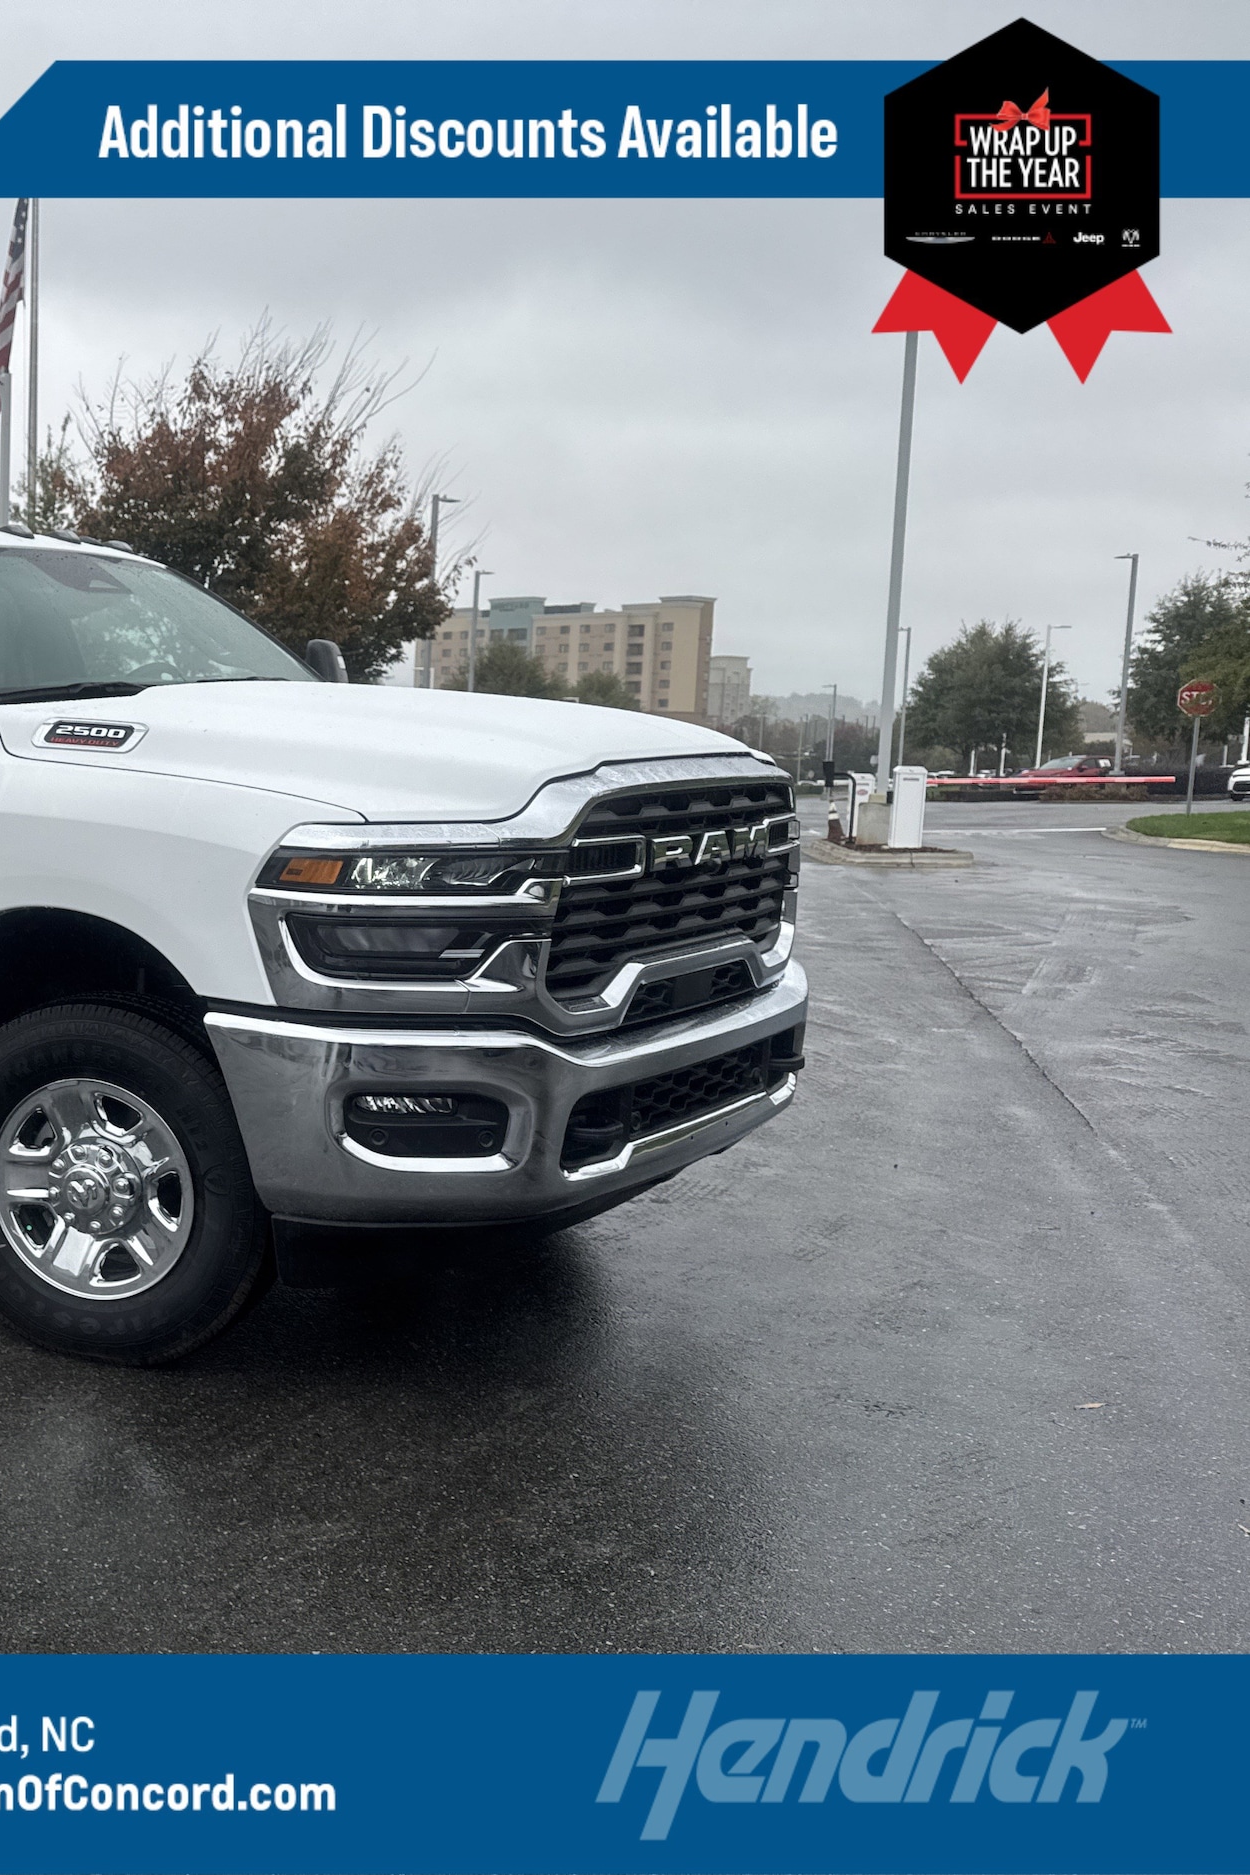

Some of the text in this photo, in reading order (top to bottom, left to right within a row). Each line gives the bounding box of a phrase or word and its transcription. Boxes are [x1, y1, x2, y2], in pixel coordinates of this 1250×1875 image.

[55, 724, 126, 739] 2500
[50, 736, 121, 747] HEAVY DUTY
[651, 824, 768, 873] RAM
